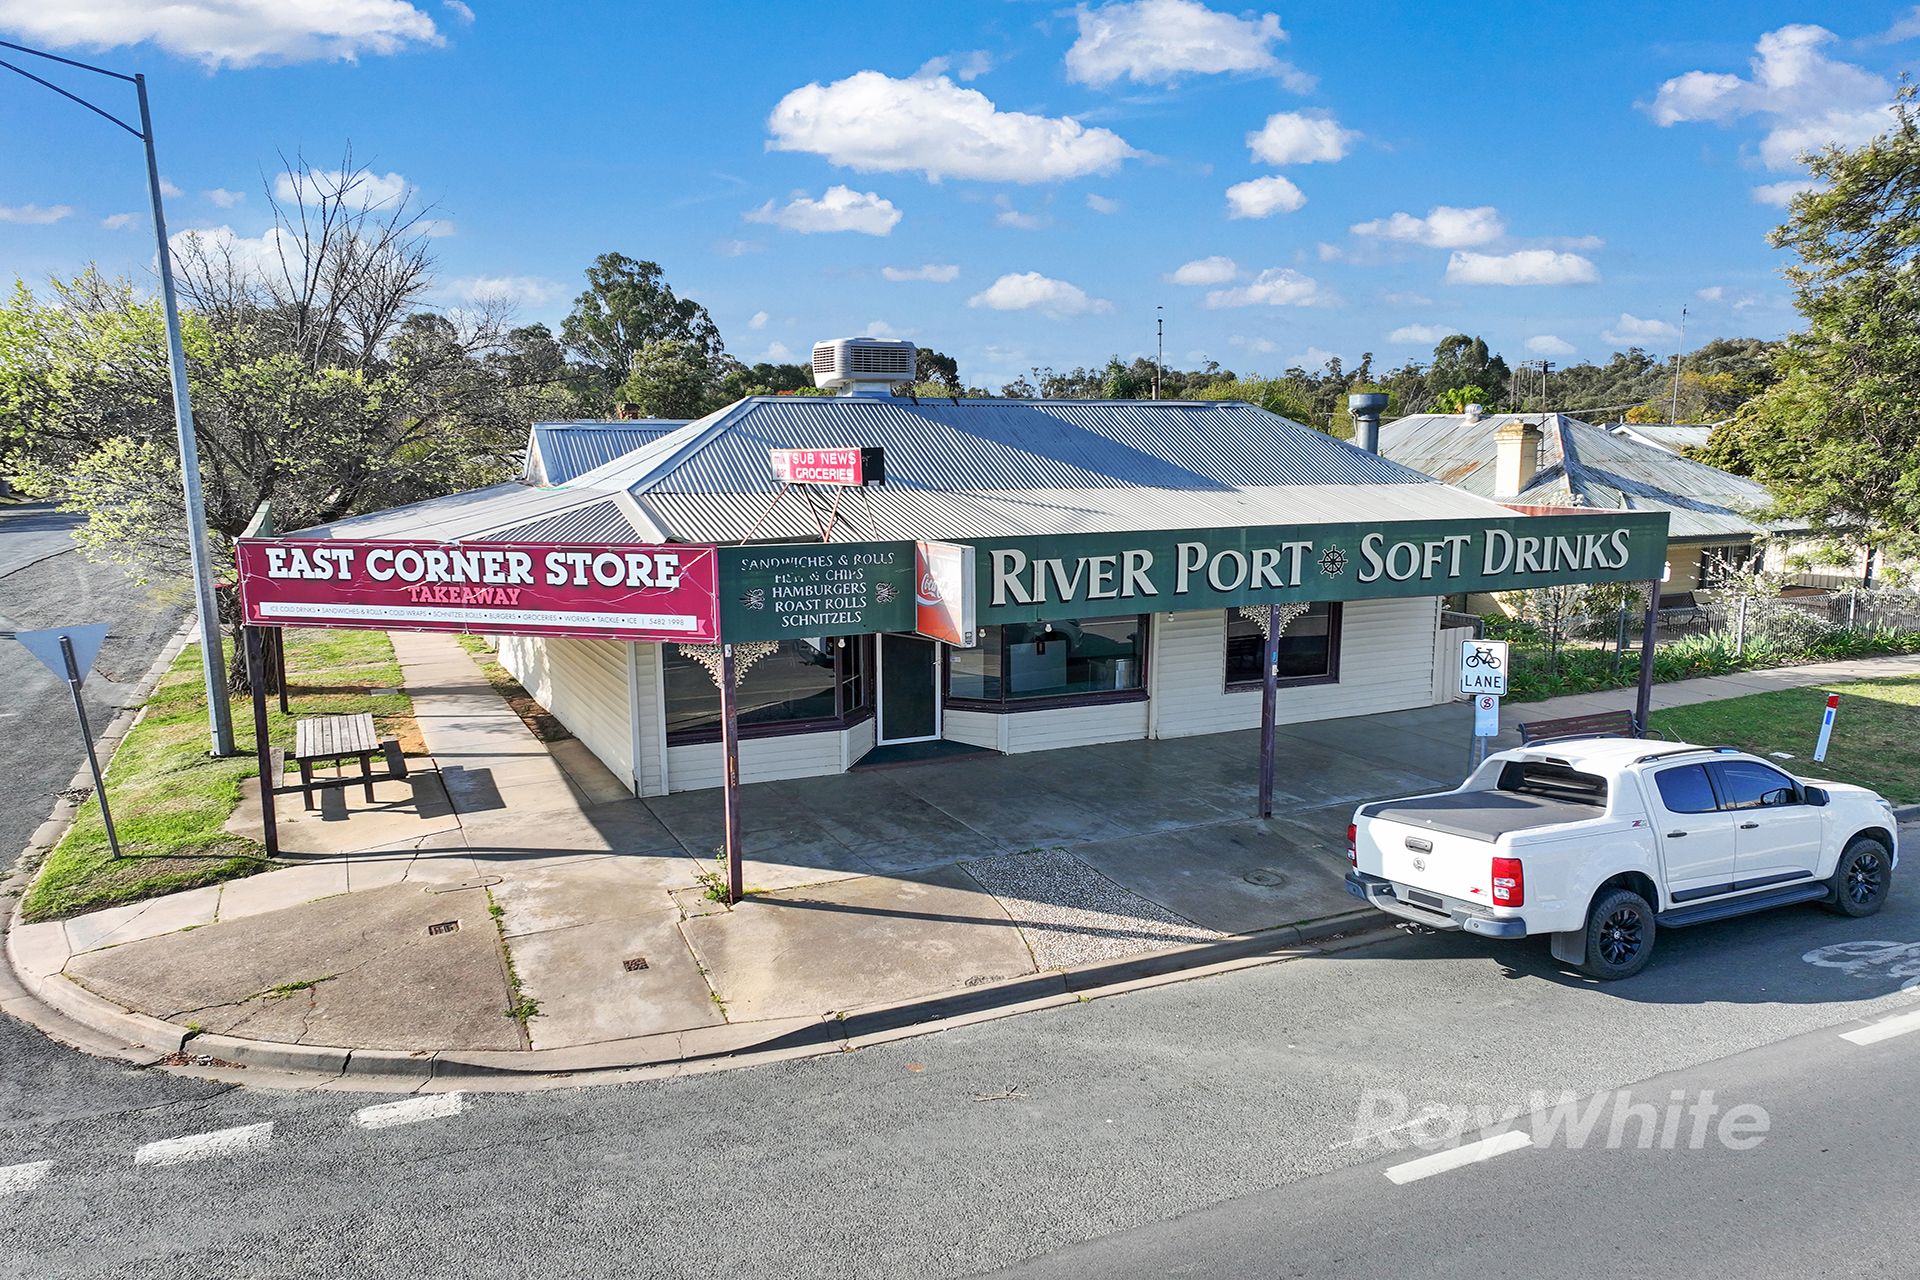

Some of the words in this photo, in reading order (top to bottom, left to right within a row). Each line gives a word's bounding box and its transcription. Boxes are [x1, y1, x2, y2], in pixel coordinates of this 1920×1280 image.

[792, 453, 815, 465] SUB
[821, 452, 857, 465] NEWS
[796, 468, 855, 480] GROCERIES
[266, 548, 354, 580] EAST
[366, 549, 535, 585] CORNER
[545, 552, 681, 588] STORE
[741, 555, 833, 571] SANDWICHES
[838, 554, 848, 566] &
[853, 552, 895, 566] ROLLS
[989, 549, 1159, 607] RIVER
[1174, 541, 1313, 595] PORT
[1357, 532, 1471, 582] SOFT
[1482, 528, 1630, 576] DRINKS
[408, 585, 521, 605] TAKEAWAY
[772, 582, 867, 598] HAMBURGERS
[775, 599, 820, 613] ROAST
[825, 596, 867, 610] ROLLS
[296, 606, 317, 614] DRINKS
[322, 607, 360, 615] SANDWICHES
[366, 608, 383, 616] ROLLS
[405, 609, 427, 617] WRAPS
[433, 610, 464, 618] SCHNITZEL
[465, 612, 482, 620] ROLLS
[564, 615, 590, 623] WORMS
[597, 616, 620, 624] TACKLE
[649, 618, 666, 626] 5482
[781, 611, 862, 628] SCHNITZELS
[1465, 675, 1501, 688] LANE
